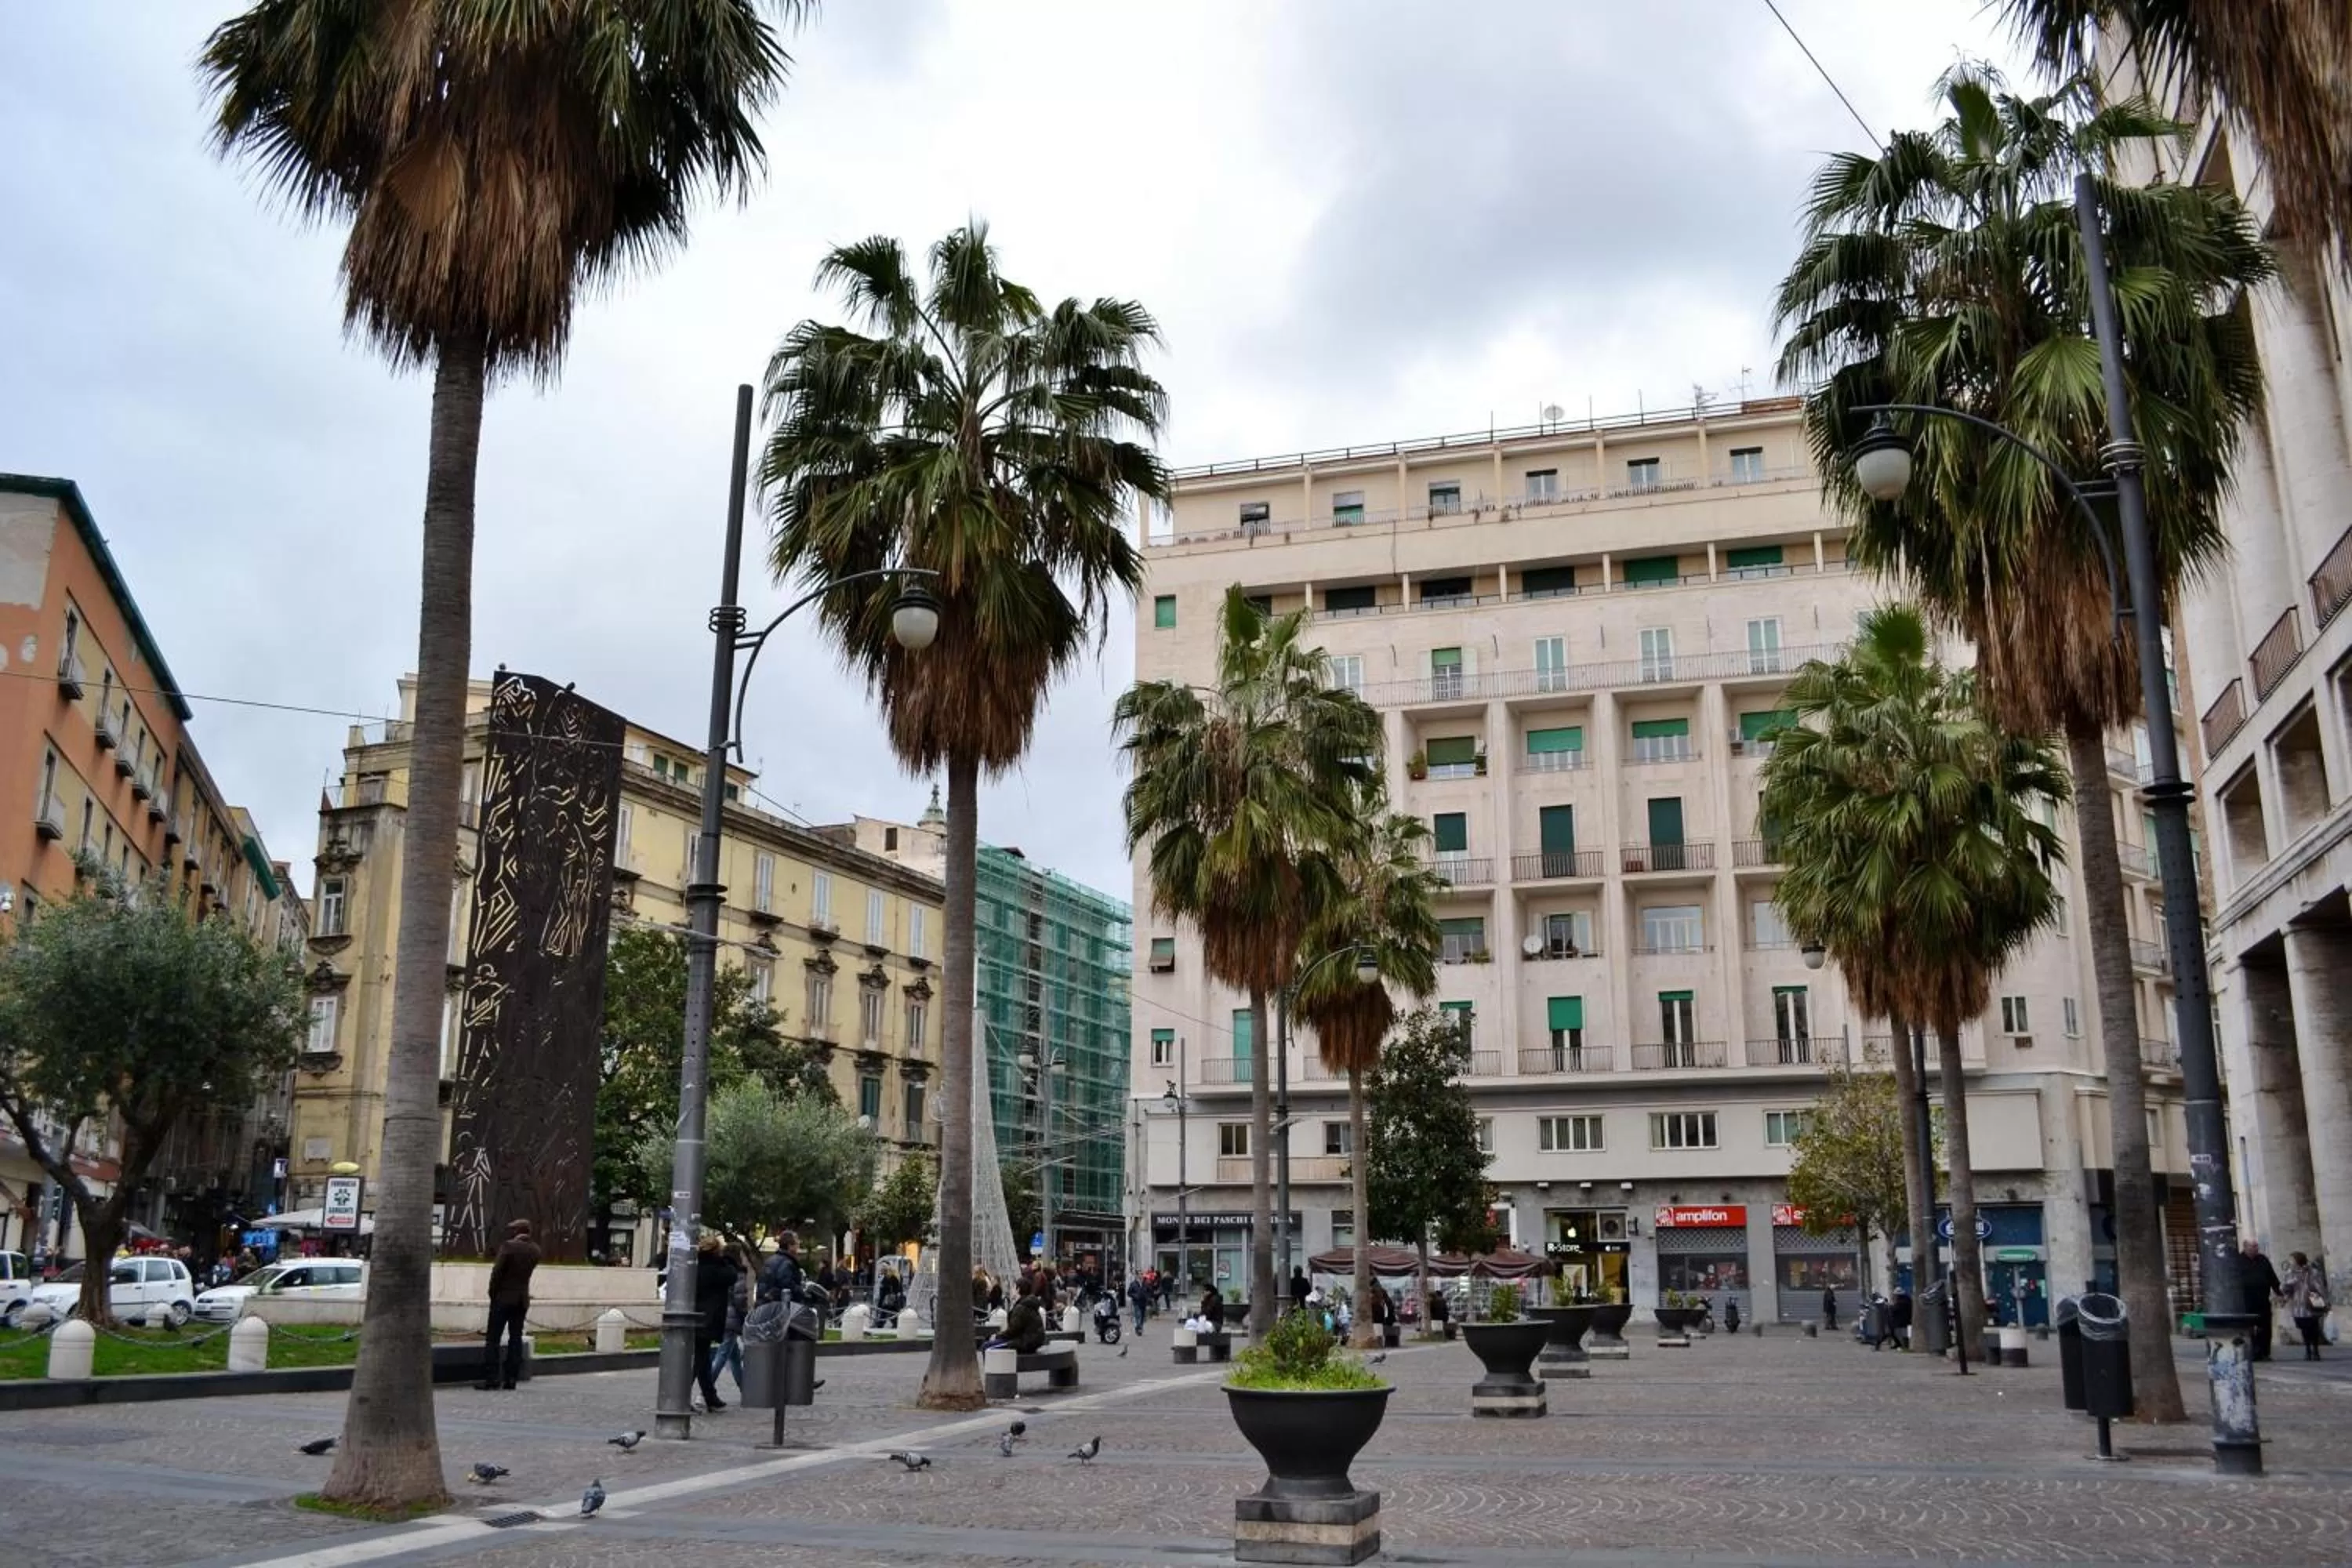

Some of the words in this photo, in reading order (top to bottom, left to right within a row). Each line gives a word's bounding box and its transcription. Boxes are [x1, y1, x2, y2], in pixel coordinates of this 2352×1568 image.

[1156, 1216, 1191, 1225] MONE
[1194, 1216, 1210, 1225] DEI
[1214, 1216, 1247, 1225] PASCHI
[1675, 1209, 1728, 1224] amplifon
